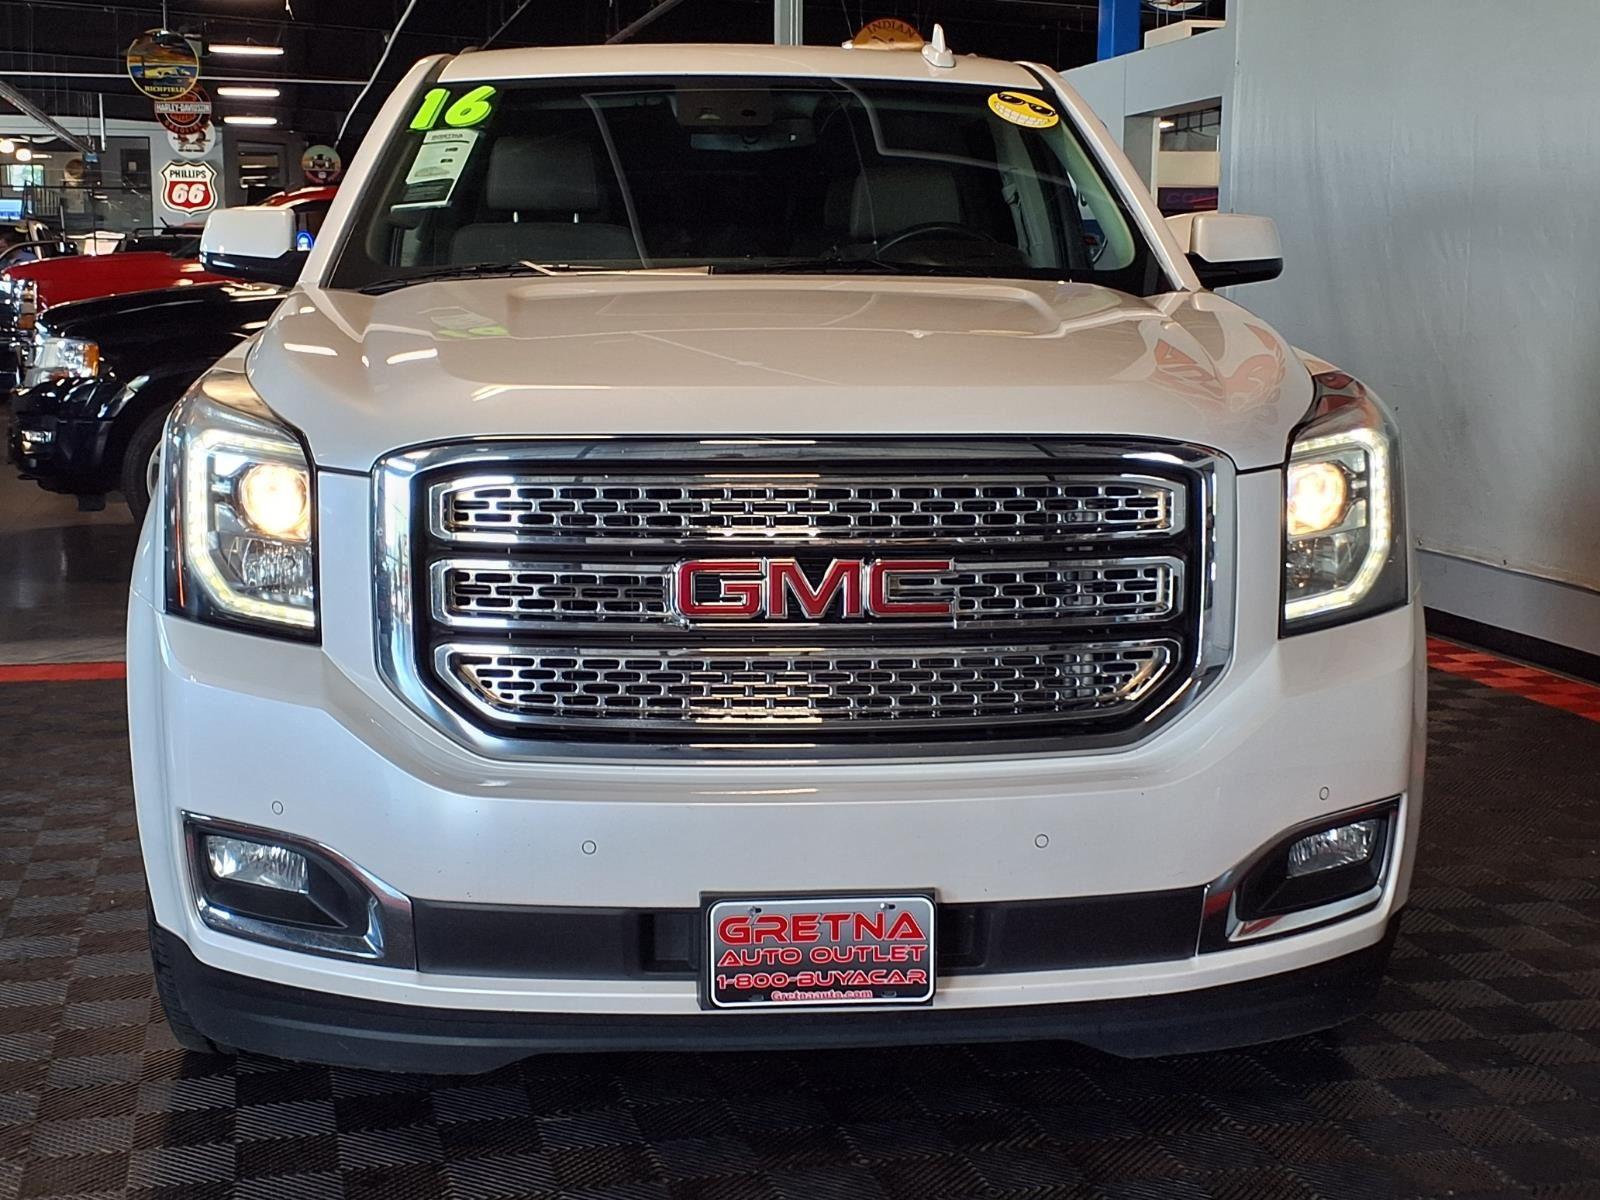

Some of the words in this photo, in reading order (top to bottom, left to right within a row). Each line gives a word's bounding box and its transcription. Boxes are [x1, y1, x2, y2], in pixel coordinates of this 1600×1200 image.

[867, 20, 913, 38] INDIAN
[145, 86, 186, 94] RICHFIELD
[157, 103, 210, 112] HARLEY-DAVIDSON
[410, 85, 496, 130] 16
[170, 170, 207, 179] PHILLIPS
[172, 183, 206, 204] 66
[675, 558, 954, 619] GMC
[717, 911, 927, 946] GRETNA
[717, 947, 803, 967] AUTO
[809, 944, 928, 964] OUTLET
[716, 969, 928, 989] 1-800-BUYACAR
[771, 989, 873, 1001] Gretnaauto.com
